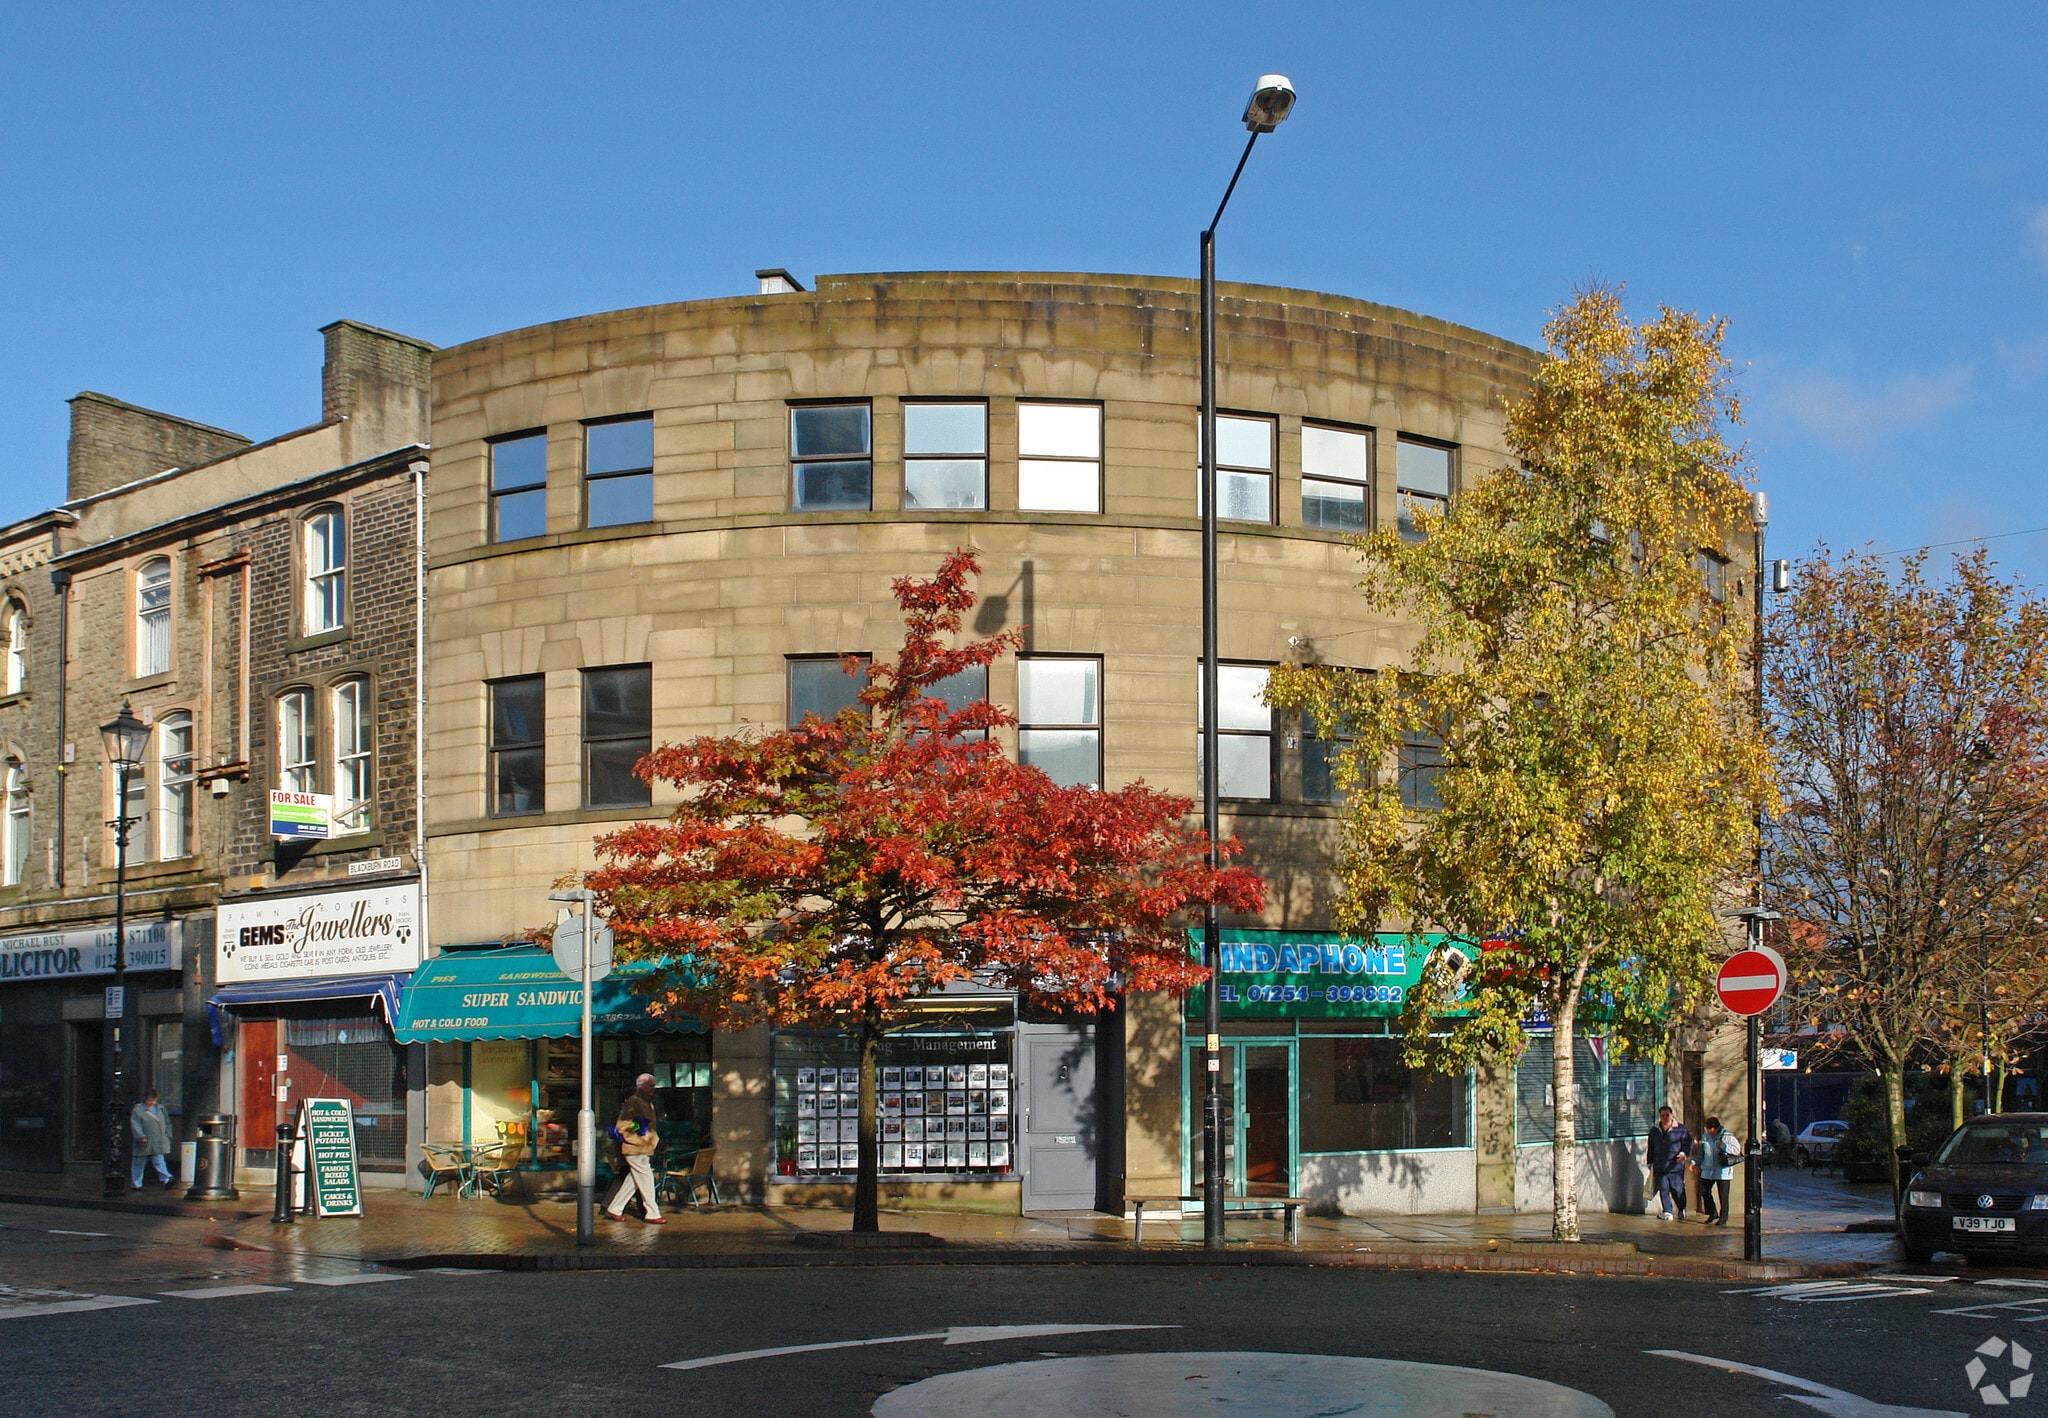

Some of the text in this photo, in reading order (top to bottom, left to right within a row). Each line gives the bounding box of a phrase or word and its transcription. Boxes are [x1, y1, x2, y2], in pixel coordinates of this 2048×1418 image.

[272, 791, 316, 806] FOR SALE
[350, 858, 399, 874] BLACKBURN ROAD
[239, 923, 285, 948] GEMS
[293, 899, 394, 954] Jewellers
[2, 935, 65, 950] MICHAEL RUST
[95, 927, 166, 948] 0125 871100
[0, 948, 82, 978] LICITOR
[128, 949, 166, 967] 390015
[1200, 942, 1407, 975] INDAPHONE
[431, 975, 457, 983] PIES
[461, 989, 594, 1008] SUPER SANDWIC
[1204, 985, 1240, 1002] EL
[412, 1017, 489, 1029] HOT & COLD FOOD
[844, 1038, 893, 1055] Leng
[912, 1038, 998, 1055] Management
[1059, 1065, 1068, 1080] 3
[318, 1151, 350, 1159] HOT PIES
[1959, 1218, 1981, 1229] V39
